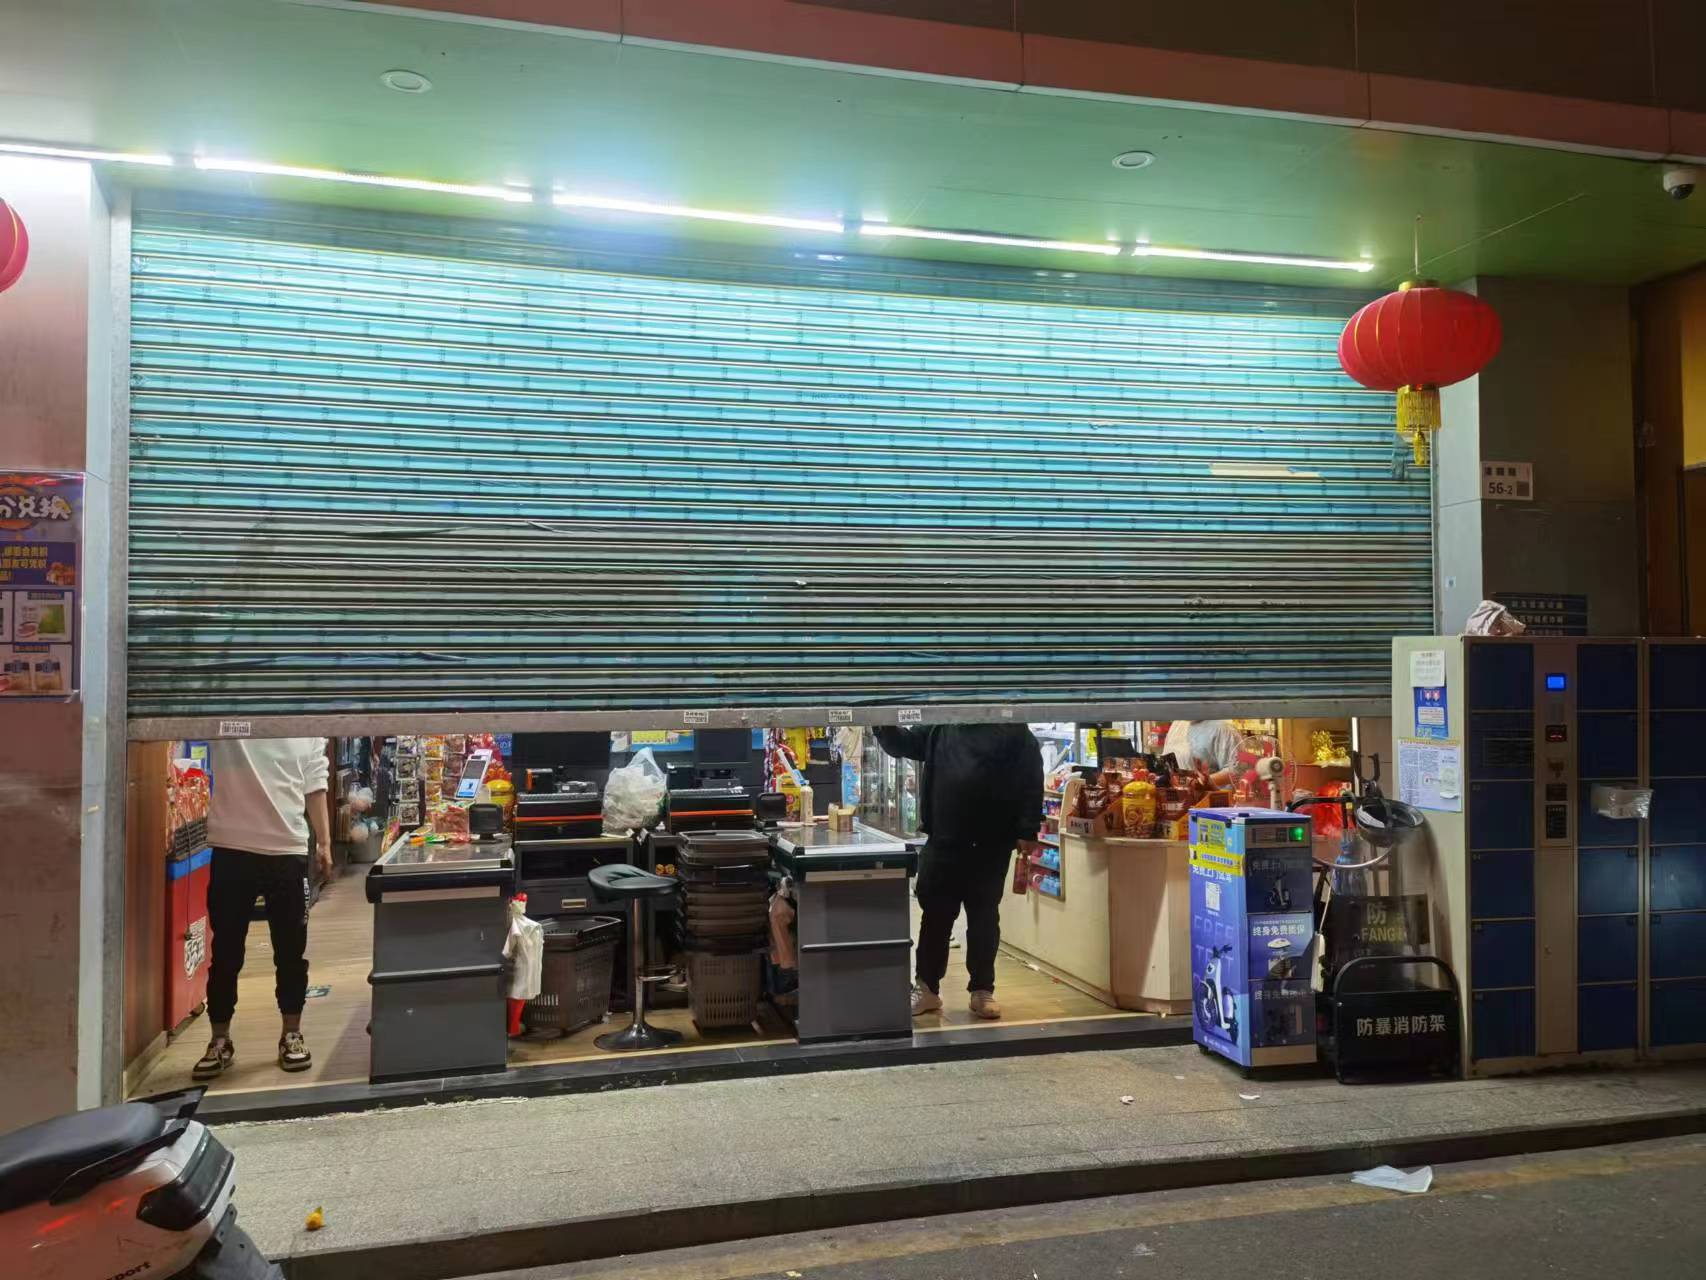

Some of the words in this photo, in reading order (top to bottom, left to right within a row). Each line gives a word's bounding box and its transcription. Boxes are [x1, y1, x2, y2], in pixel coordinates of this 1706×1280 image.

[1488, 481, 1513, 495] 56-2
[1356, 1014, 1447, 1037] 防暴消防架
[106, 1261, 152, 1280] port
